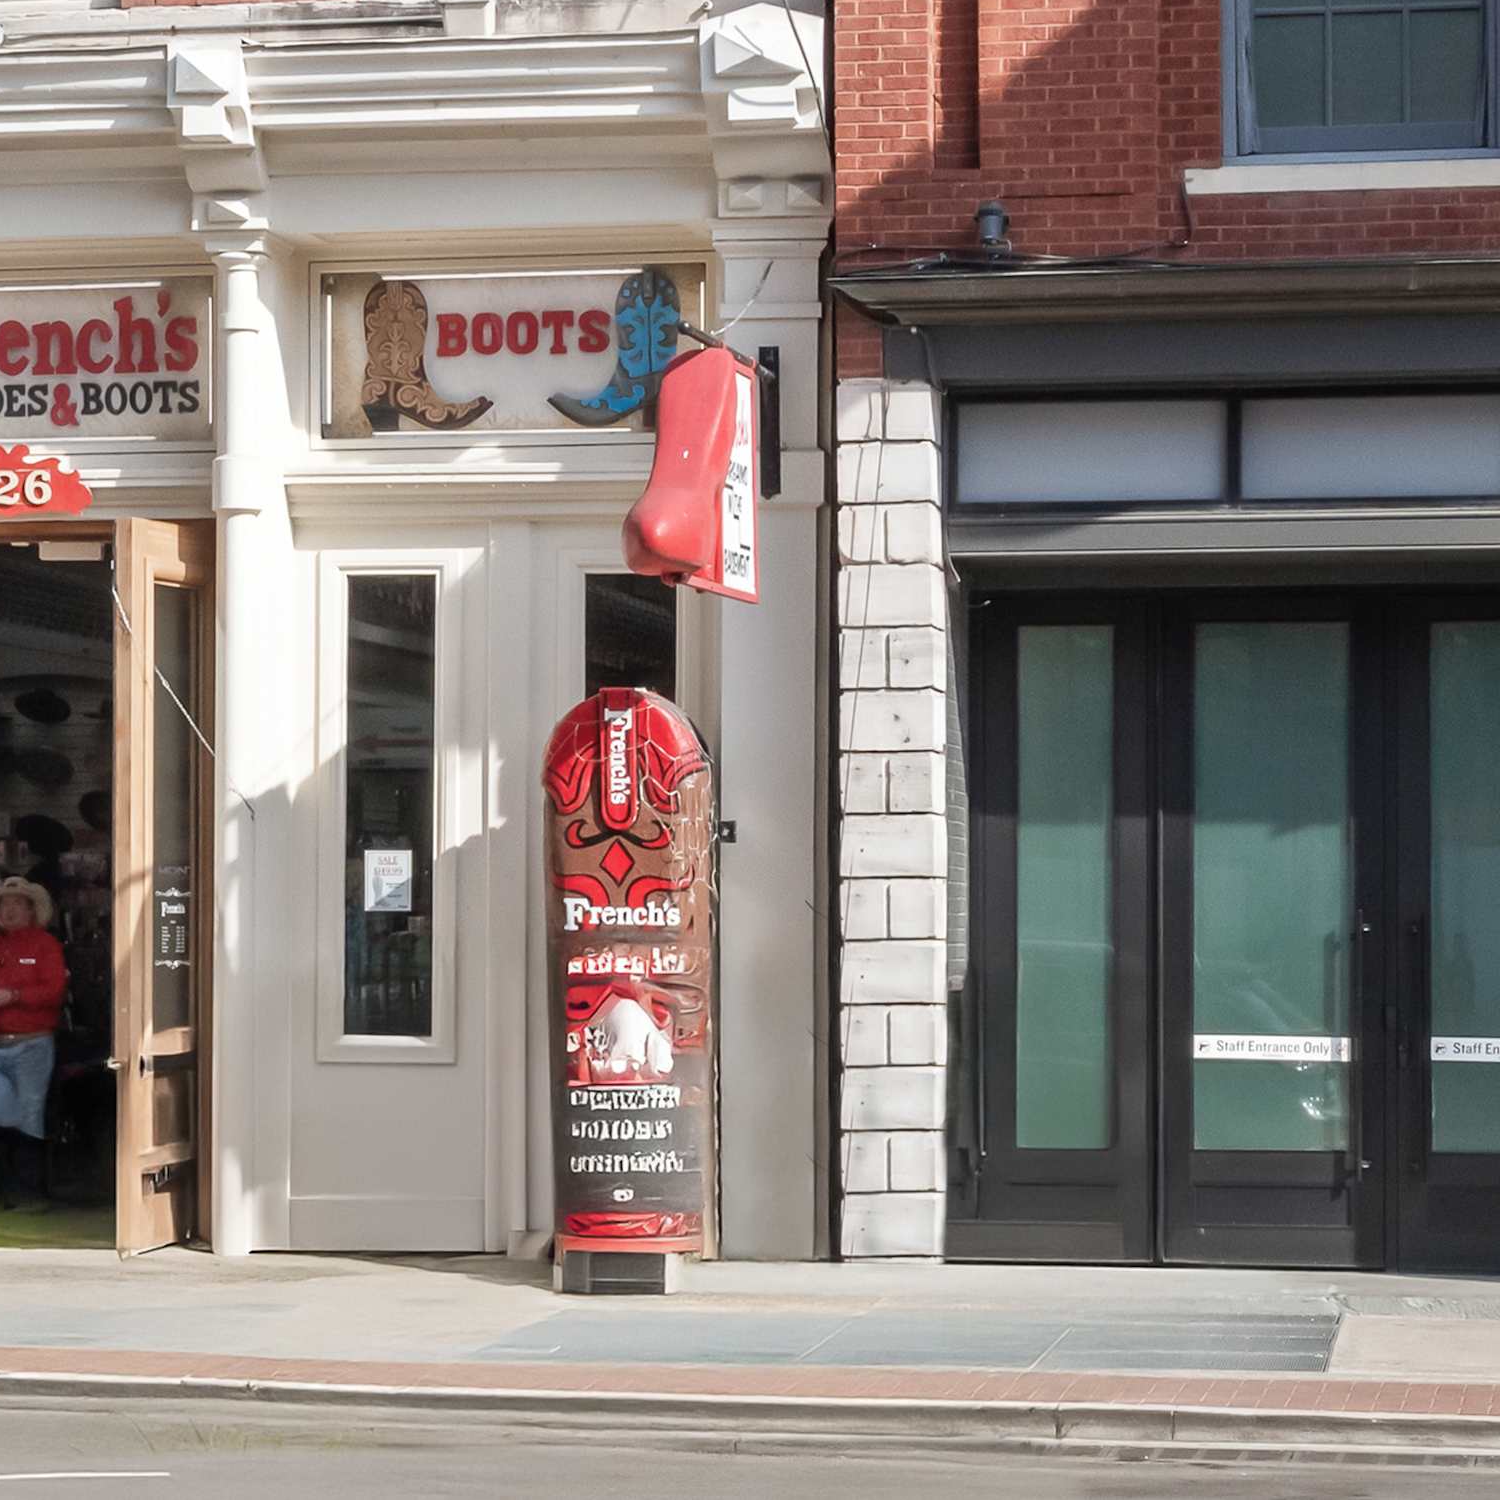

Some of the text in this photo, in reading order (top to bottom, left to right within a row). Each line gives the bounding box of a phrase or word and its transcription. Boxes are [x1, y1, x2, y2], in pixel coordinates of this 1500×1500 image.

[436, 309, 612, 358] BOOTS
[50, 383, 80, 426] &
[81, 380, 200, 416] BOOTS
[603, 707, 635, 805] French's
[563, 897, 681, 931] French's
[1216, 1040, 1330, 1056] Staff Entrance Only
[1452, 1042, 1482, 1054] Staff
